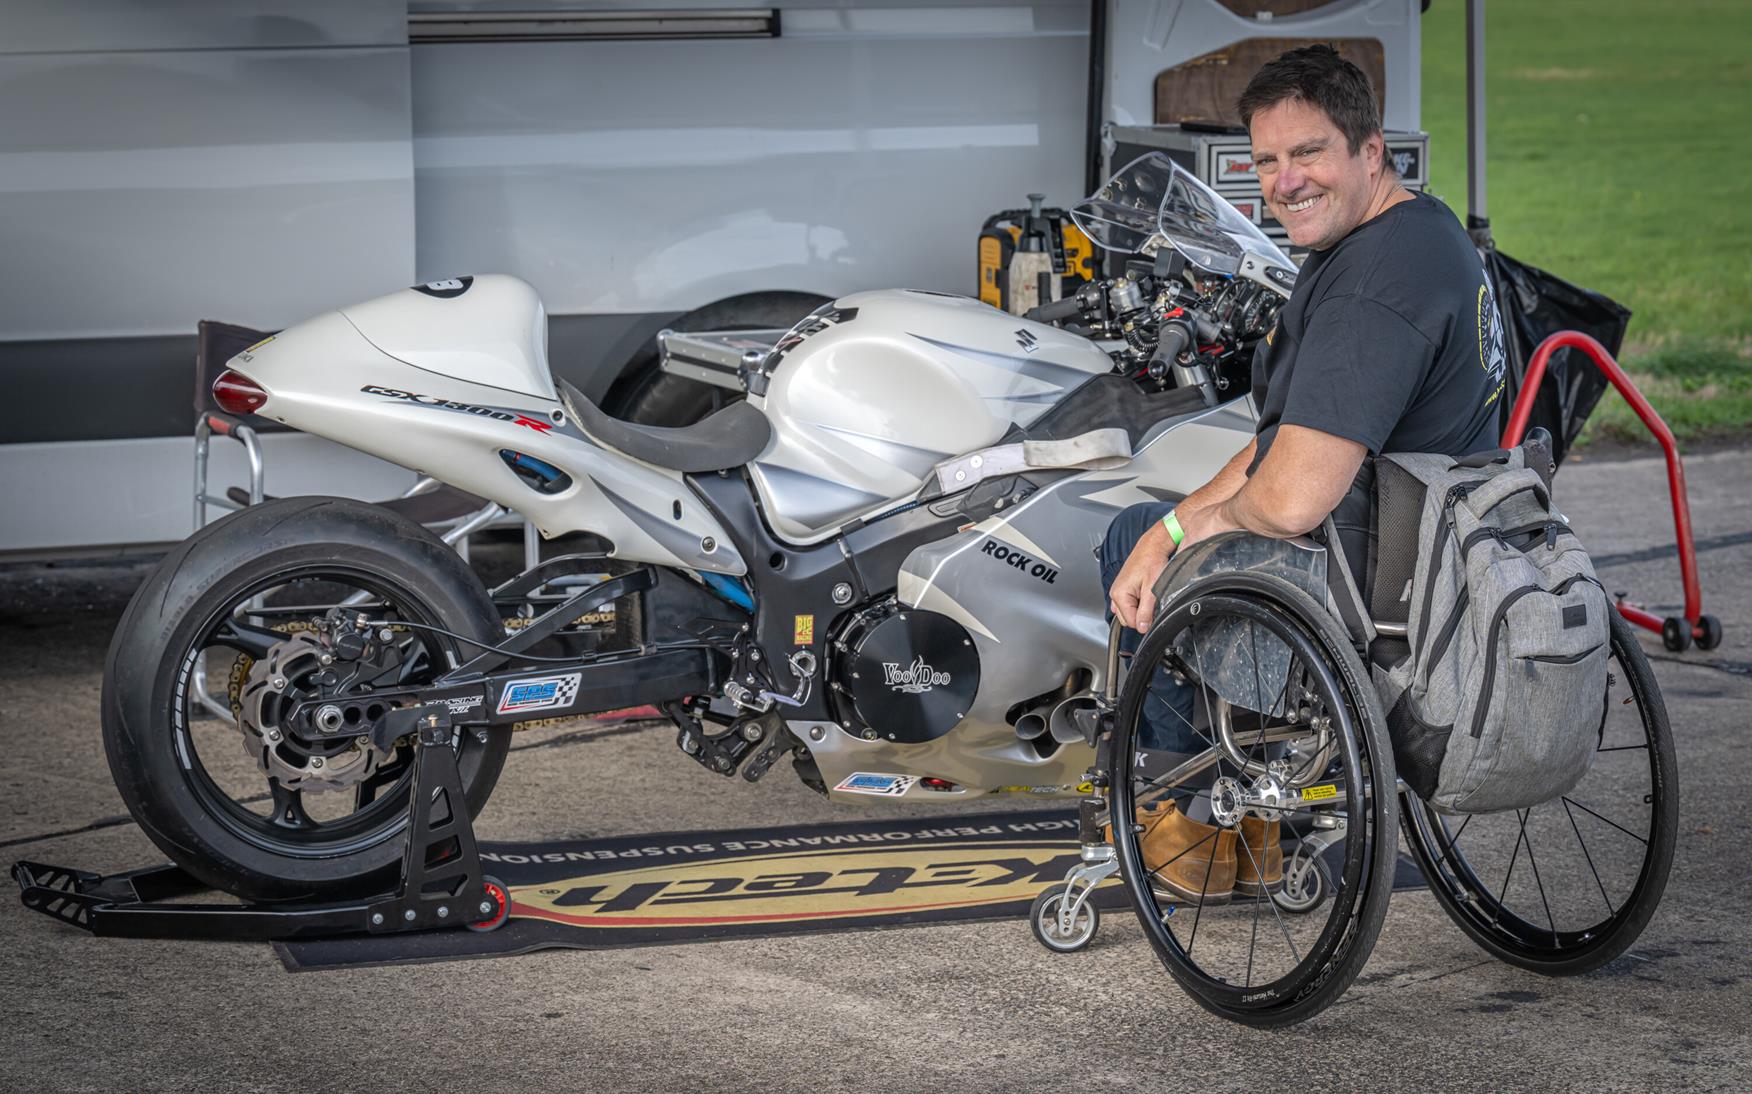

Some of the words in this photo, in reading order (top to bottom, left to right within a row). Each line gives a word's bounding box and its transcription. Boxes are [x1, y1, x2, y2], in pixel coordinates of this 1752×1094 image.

[981, 540, 1032, 572] ROCK
[1031, 563, 1059, 585] OIL
[721, 825, 1003, 852] PERFORMANCE
[479, 841, 716, 864] SUSPENSION
